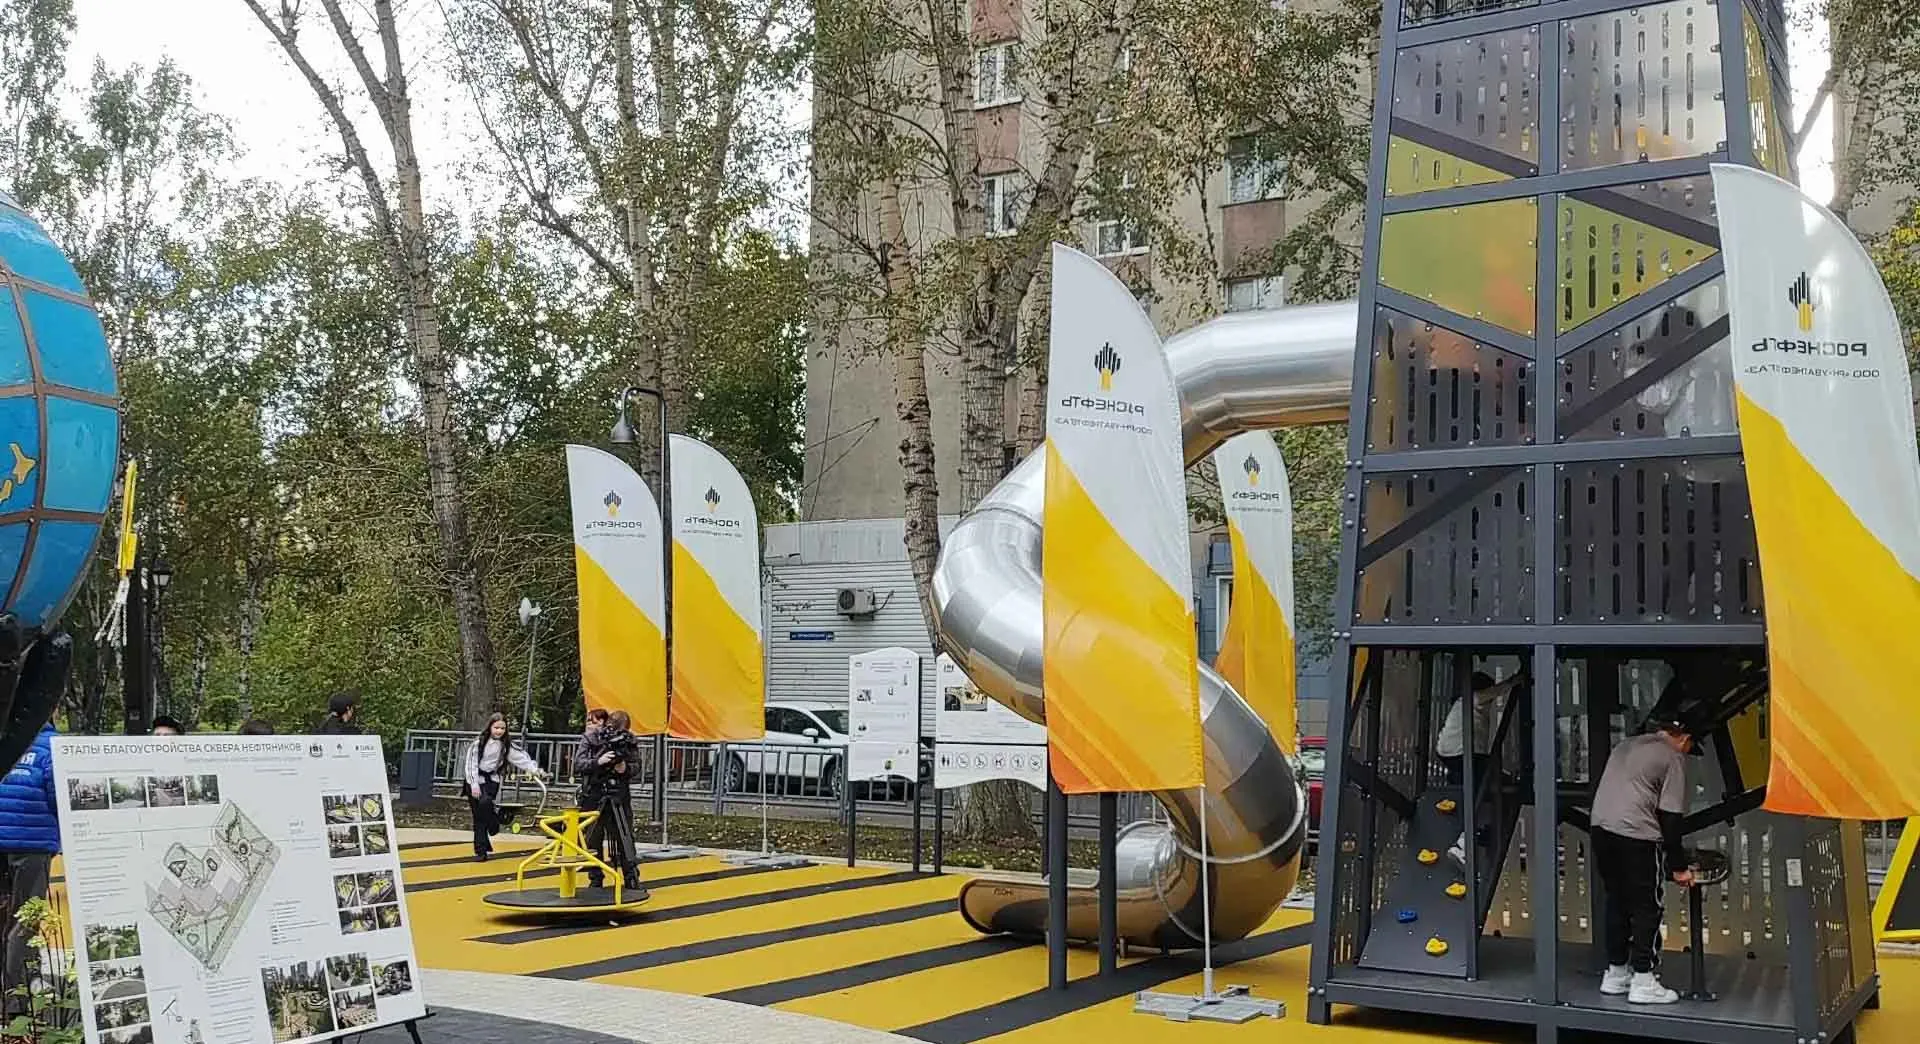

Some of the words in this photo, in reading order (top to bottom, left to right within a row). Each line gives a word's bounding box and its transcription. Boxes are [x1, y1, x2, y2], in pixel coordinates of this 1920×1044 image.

[103, 742, 201, 755] БЛАГОУСТРОЙСТВА
[203, 743, 240, 753] СКВЕРА
[242, 743, 302, 752] НЕФТЯНИКОВ
